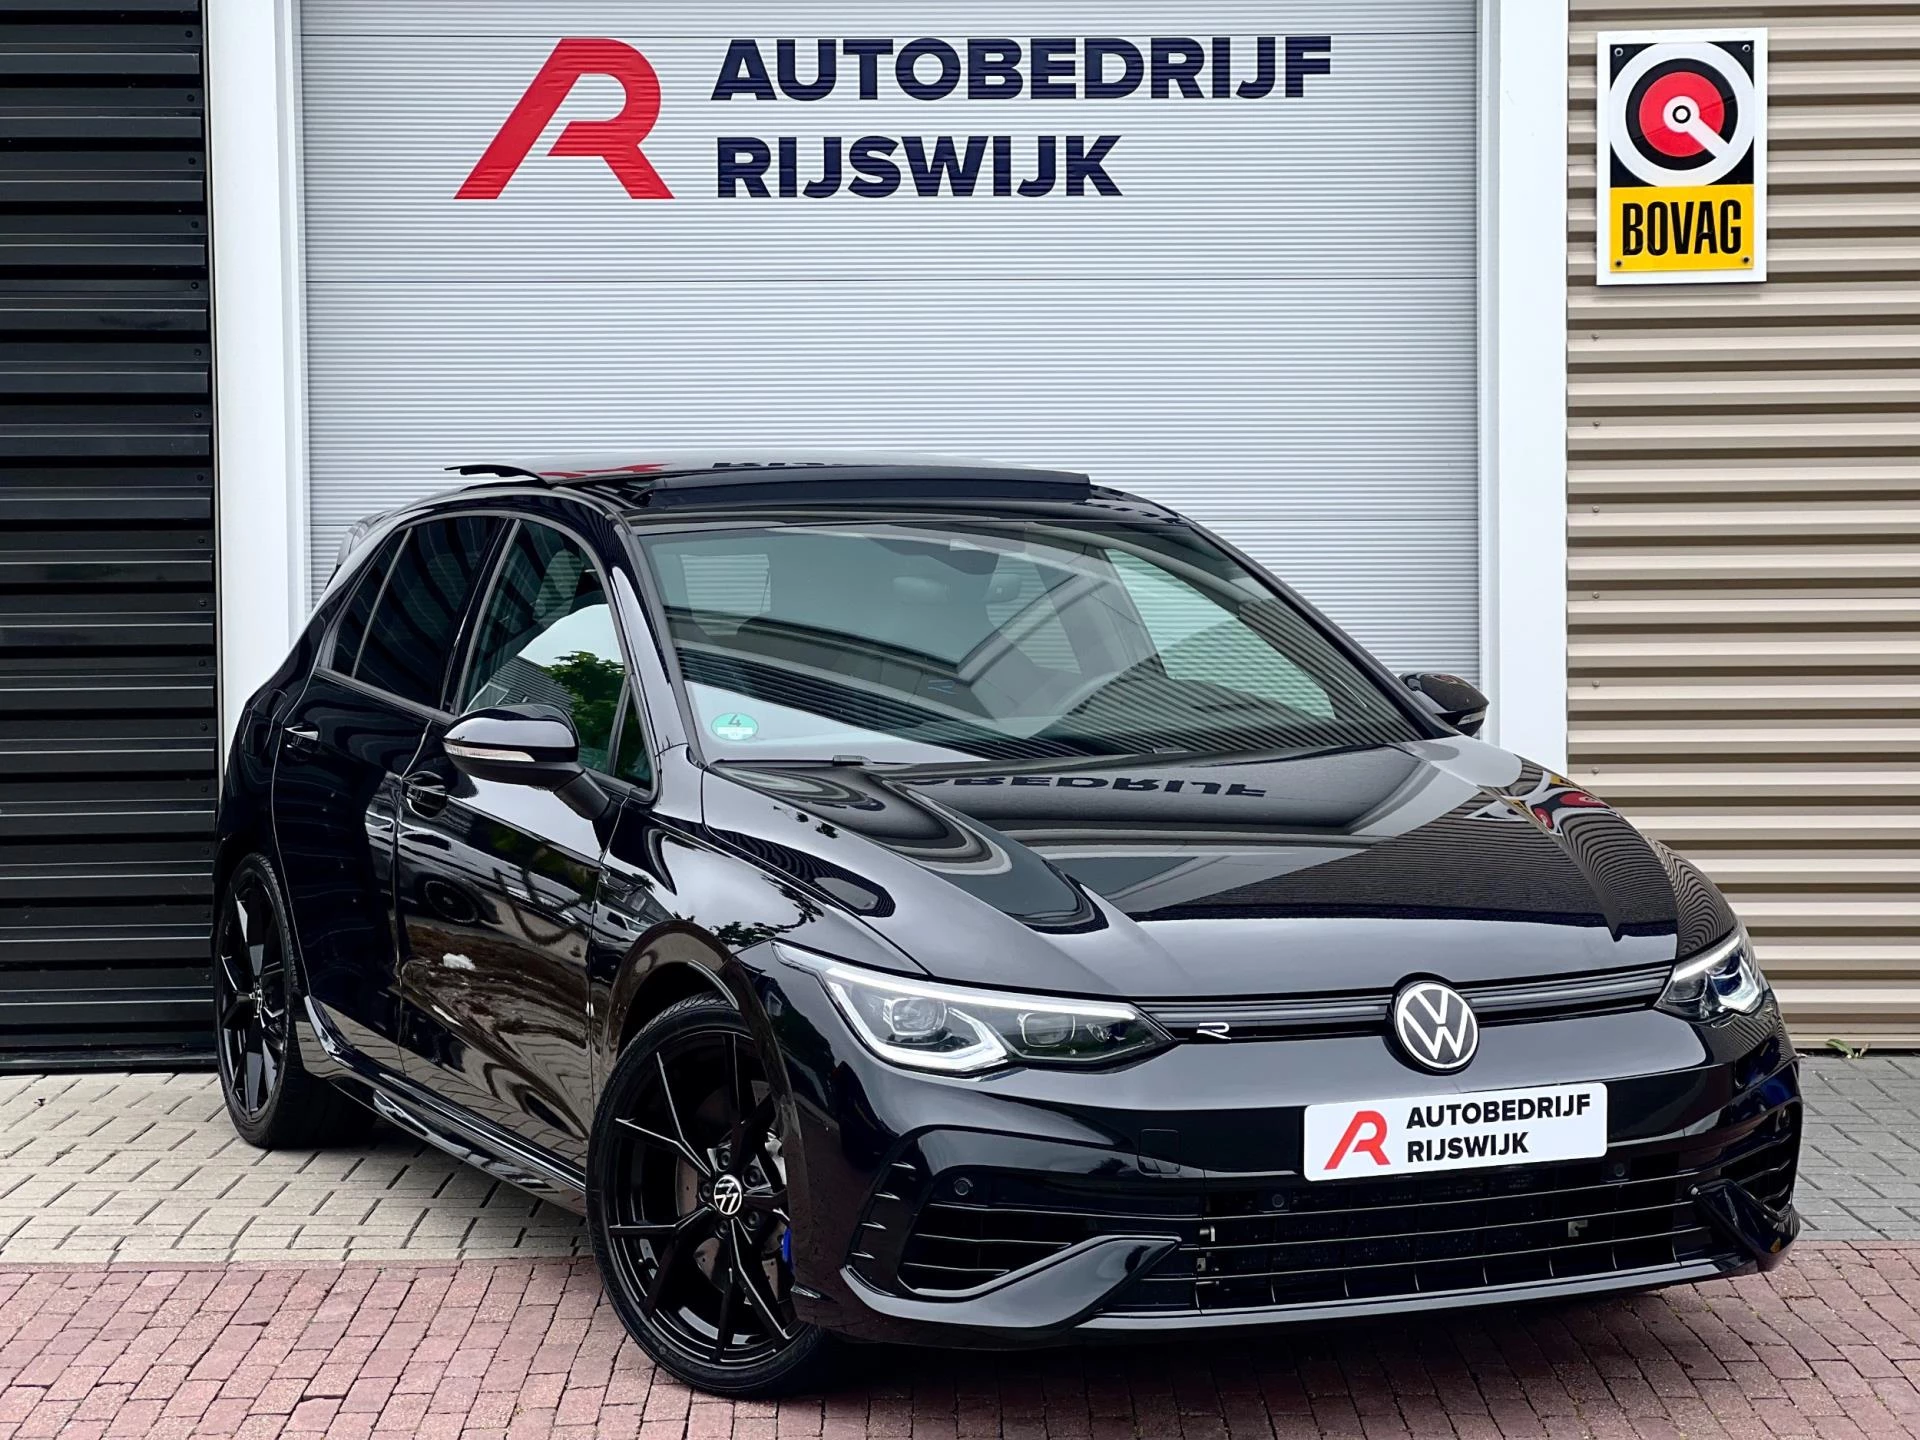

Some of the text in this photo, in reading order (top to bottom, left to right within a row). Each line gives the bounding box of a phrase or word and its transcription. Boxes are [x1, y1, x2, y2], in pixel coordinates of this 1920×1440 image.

[711, 36, 1332, 102] AUTOBEDRIJF
[716, 135, 1122, 199] RIJSWIJK
[1622, 199, 1742, 256] BOVAG
[727, 713, 742, 727] 4
[1406, 1093, 1592, 1129] AUTOBEDRIJF
[1407, 1131, 1530, 1164] RIJSWIJK
